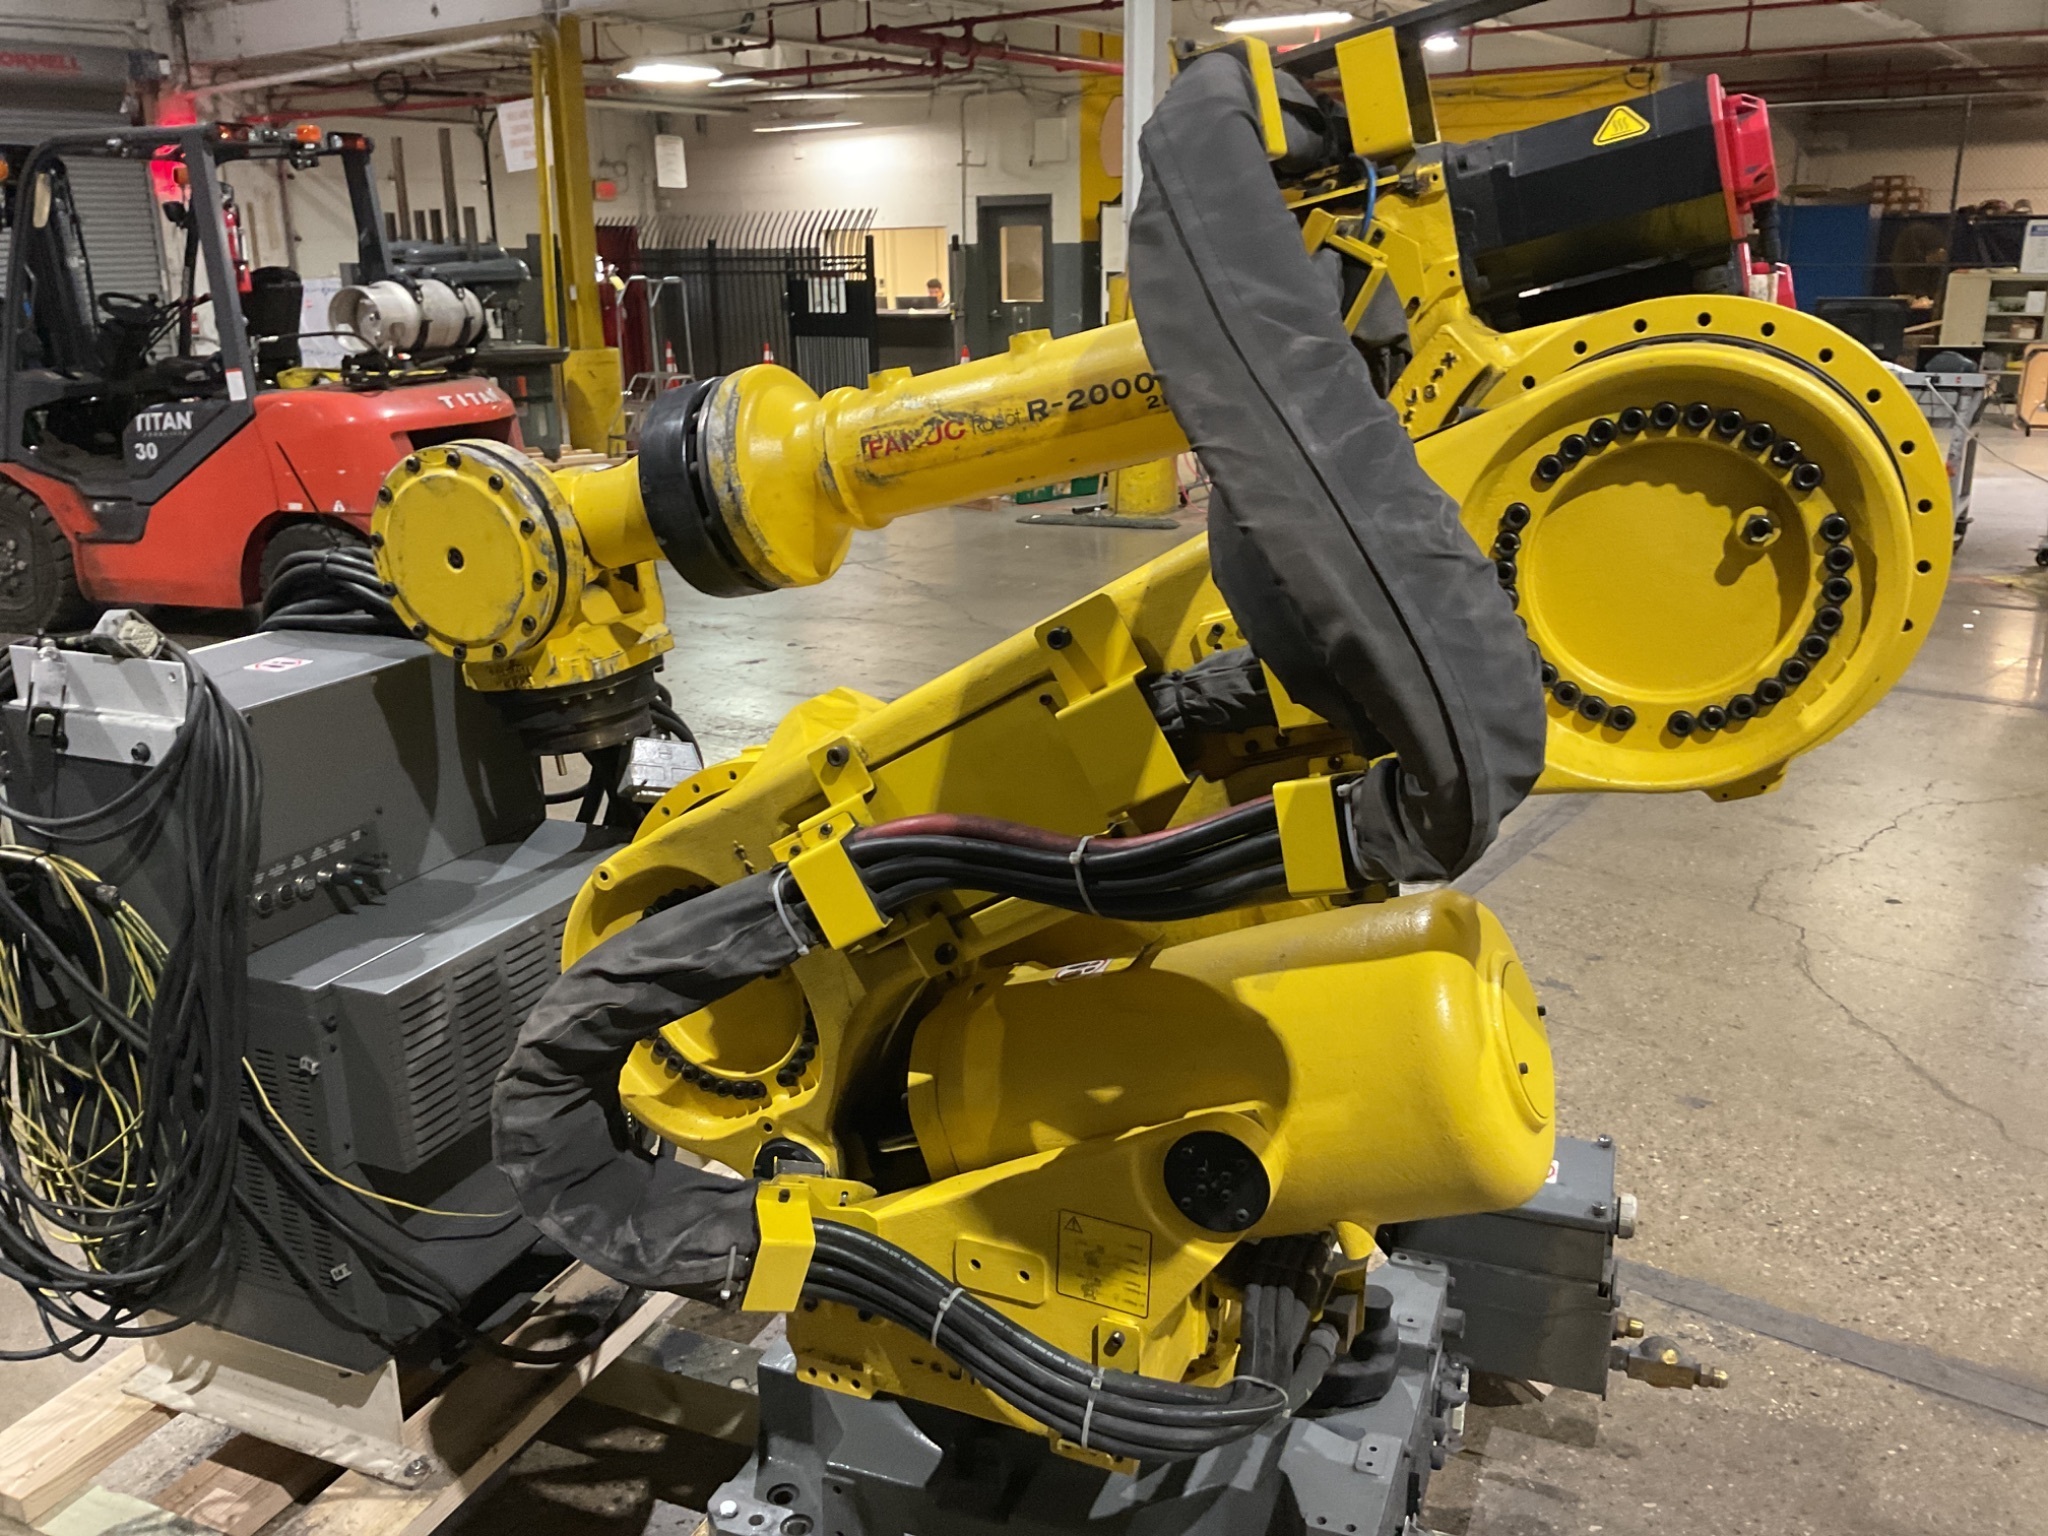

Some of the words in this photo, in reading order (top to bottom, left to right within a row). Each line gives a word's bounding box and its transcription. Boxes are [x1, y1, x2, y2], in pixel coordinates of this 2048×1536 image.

[436, 388, 502, 410] TITAN
[1026, 372, 1164, 422] R-2000
[135, 410, 193, 432] TITAN
[134, 442, 158, 460] 30
